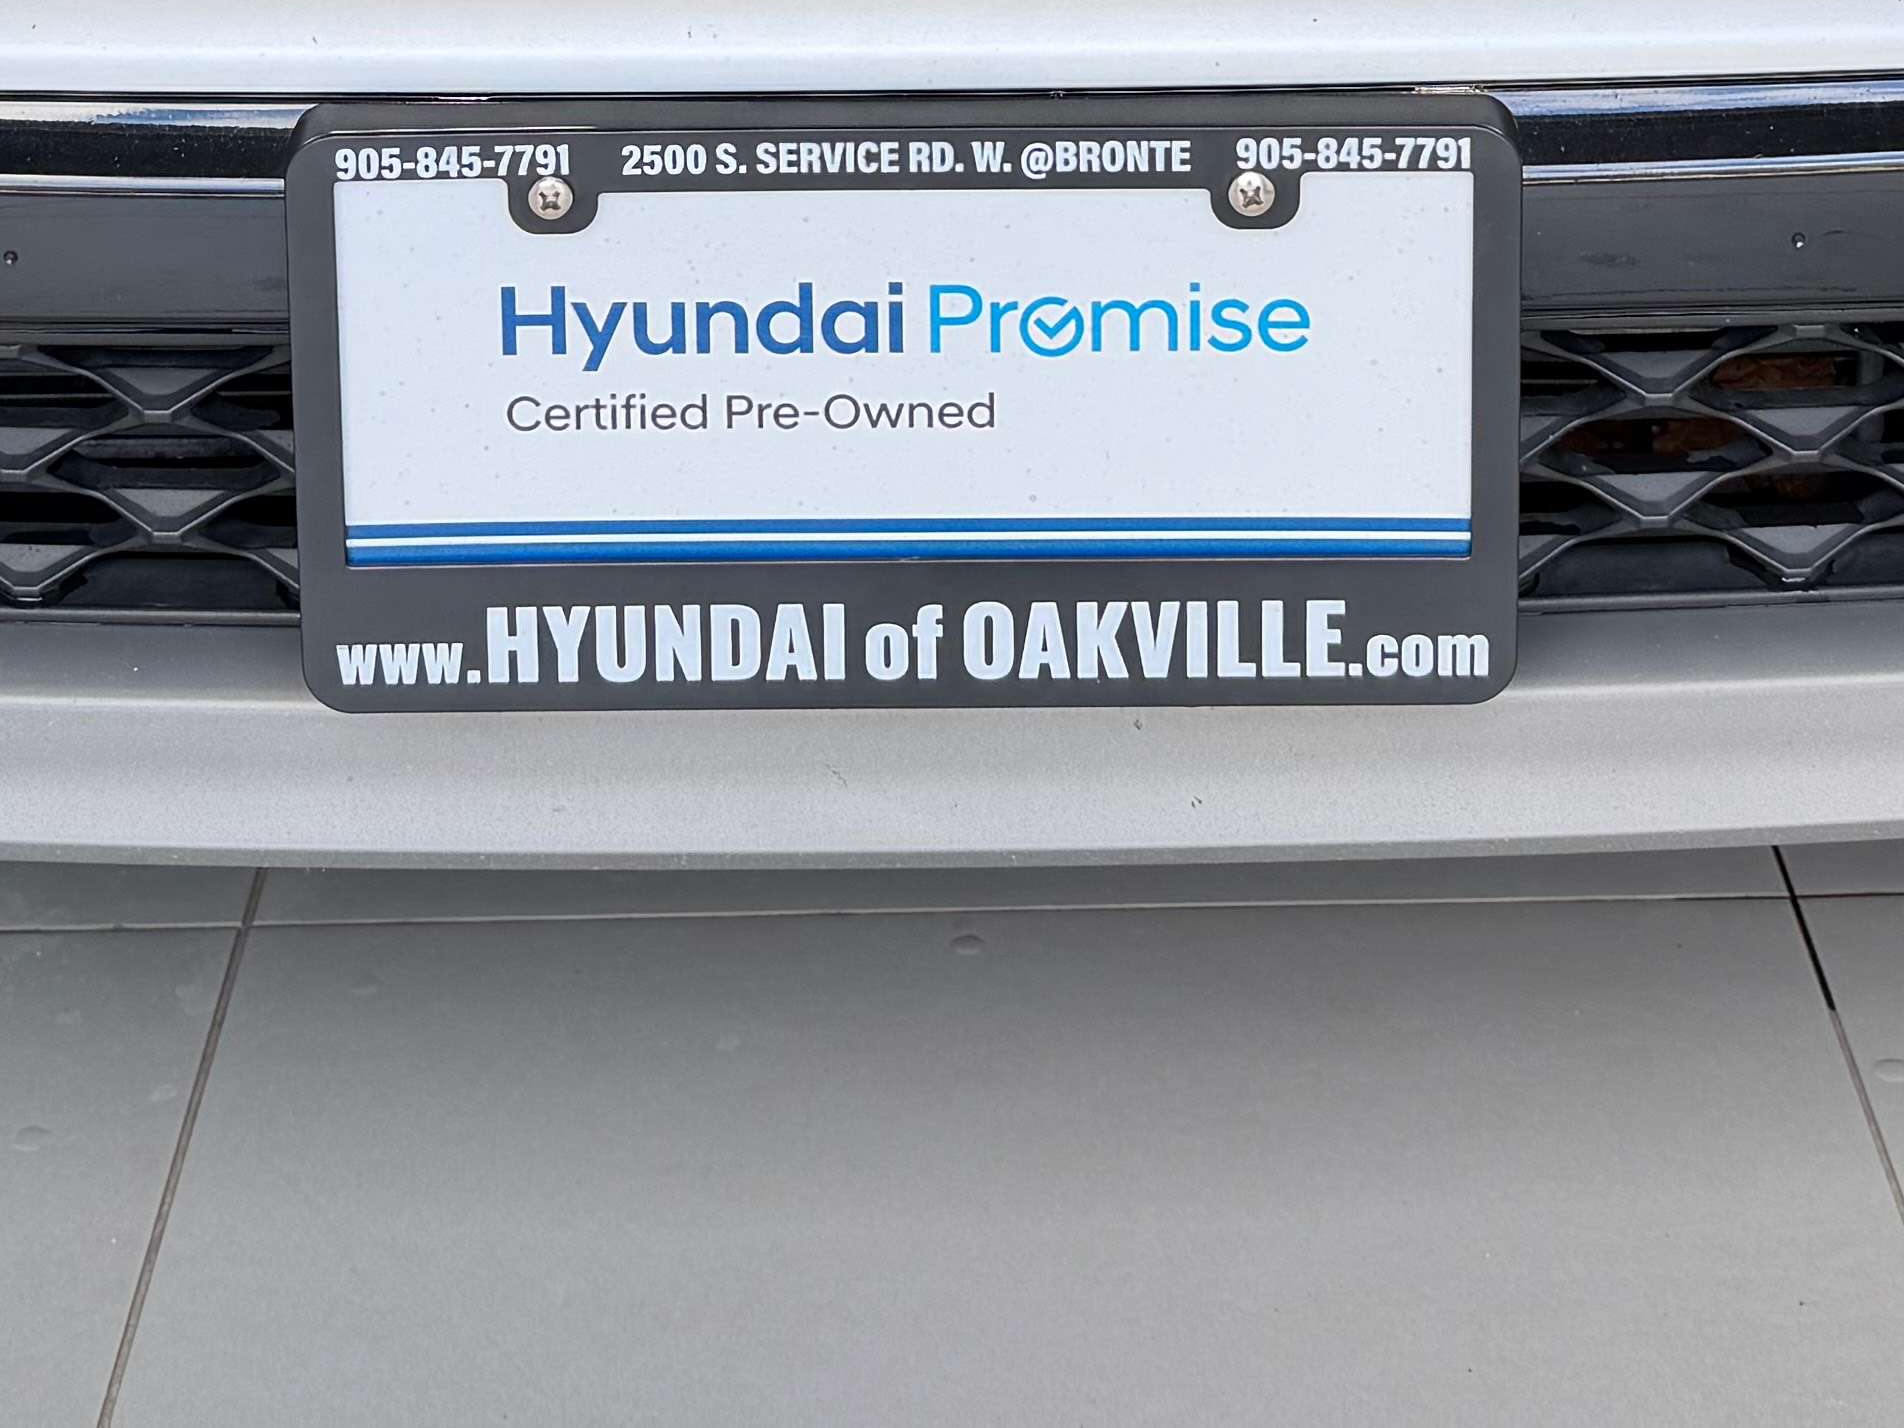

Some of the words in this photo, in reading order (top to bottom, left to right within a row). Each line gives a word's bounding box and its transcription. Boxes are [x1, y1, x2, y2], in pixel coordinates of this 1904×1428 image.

[334, 142, 571, 181] 905-845-7791
[621, 143, 707, 176] 2500
[715, 142, 747, 175] S.
[755, 141, 900, 175] SERVICE
[908, 141, 965, 174] RD.
[970, 141, 1012, 173] W.
[1019, 139, 1192, 180] @BRONTE
[1234, 136, 1472, 171] 905-845-7791
[499, 282, 905, 373] Hyundai
[927, 280, 1313, 360] Promise
[505, 391, 709, 433] Certified
[725, 391, 996, 432] Pre-Owned
[334, 602, 847, 687] www.HYUNDAI
[864, 602, 945, 682] of
[962, 598, 1491, 682] OAKVILLE.com
